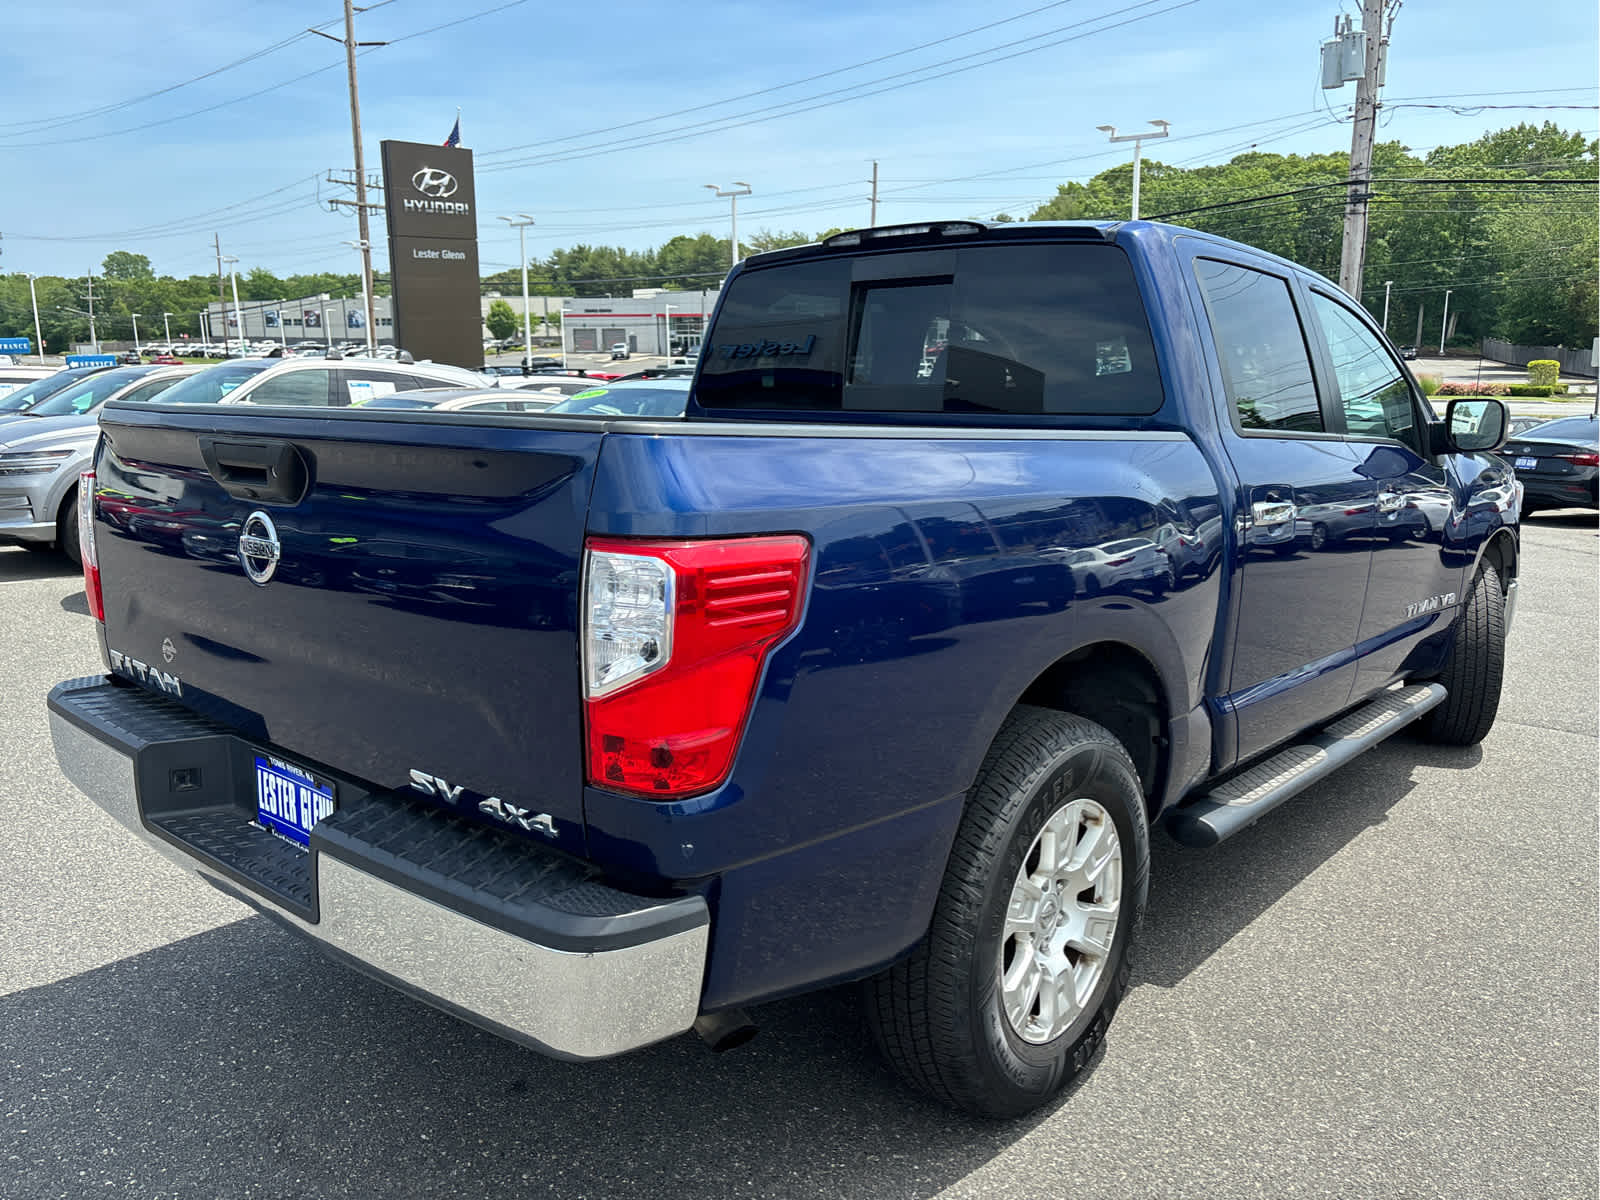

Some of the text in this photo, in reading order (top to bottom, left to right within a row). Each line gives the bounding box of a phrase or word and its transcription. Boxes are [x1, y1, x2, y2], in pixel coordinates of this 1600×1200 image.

[403, 198, 469, 215] HYUNDAI
[413, 248, 466, 261] Lester Glenn
[241, 538, 276, 558] NISSAN
[1407, 592, 1456, 618] TITAN V8
[108, 648, 182, 698] TITAN
[257, 768, 298, 825] LESTER
[409, 768, 465, 805] SV
